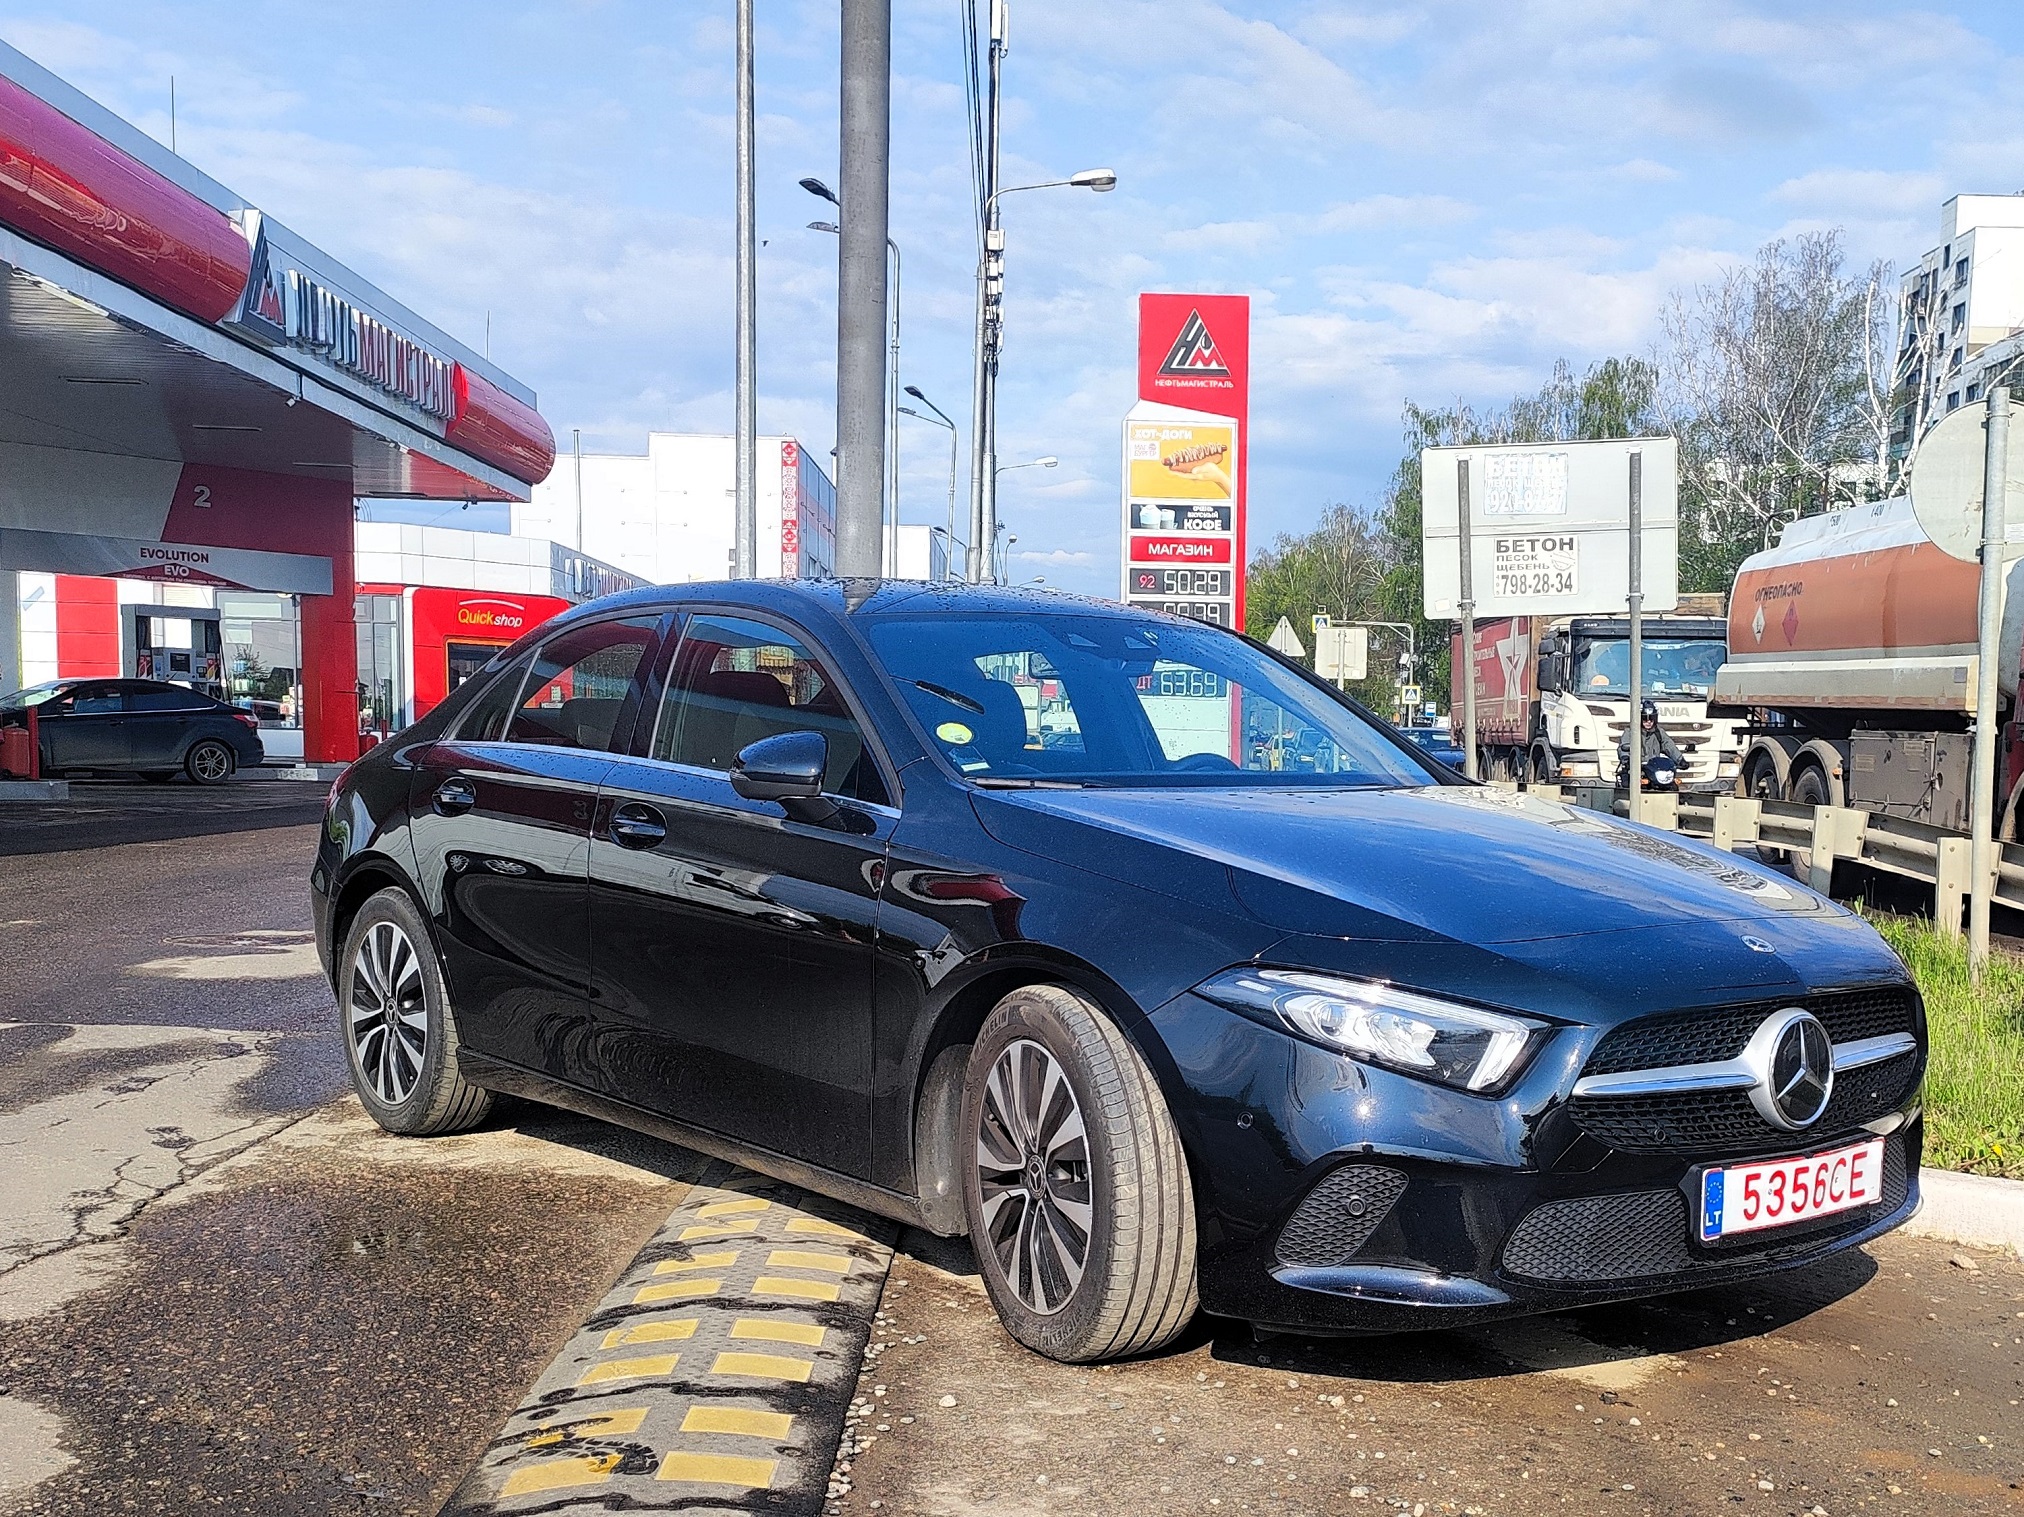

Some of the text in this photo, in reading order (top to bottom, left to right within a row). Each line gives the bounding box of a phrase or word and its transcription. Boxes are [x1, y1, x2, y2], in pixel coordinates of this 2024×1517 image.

[1155, 379, 1234, 388] НЕФТЬМАГИСТРАЛЬ
[193, 485, 212, 508] 2
[1183, 518, 1222, 530] КОФЕ
[1148, 542, 1213, 556] МАГАЗИН
[1496, 537, 1574, 553] БЕТОН
[140, 548, 209, 563] EVOLUTION
[1496, 554, 1538, 562] ПЕСОК
[164, 564, 190, 577] EVO
[1496, 563, 1550, 572] ЩЕБЕНЬ
[1139, 570, 1220, 594] 92 50.29
[1136, 671, 1217, 696] ДТ 63.69
[1705, 1151, 1868, 1227] LT 5356CE
